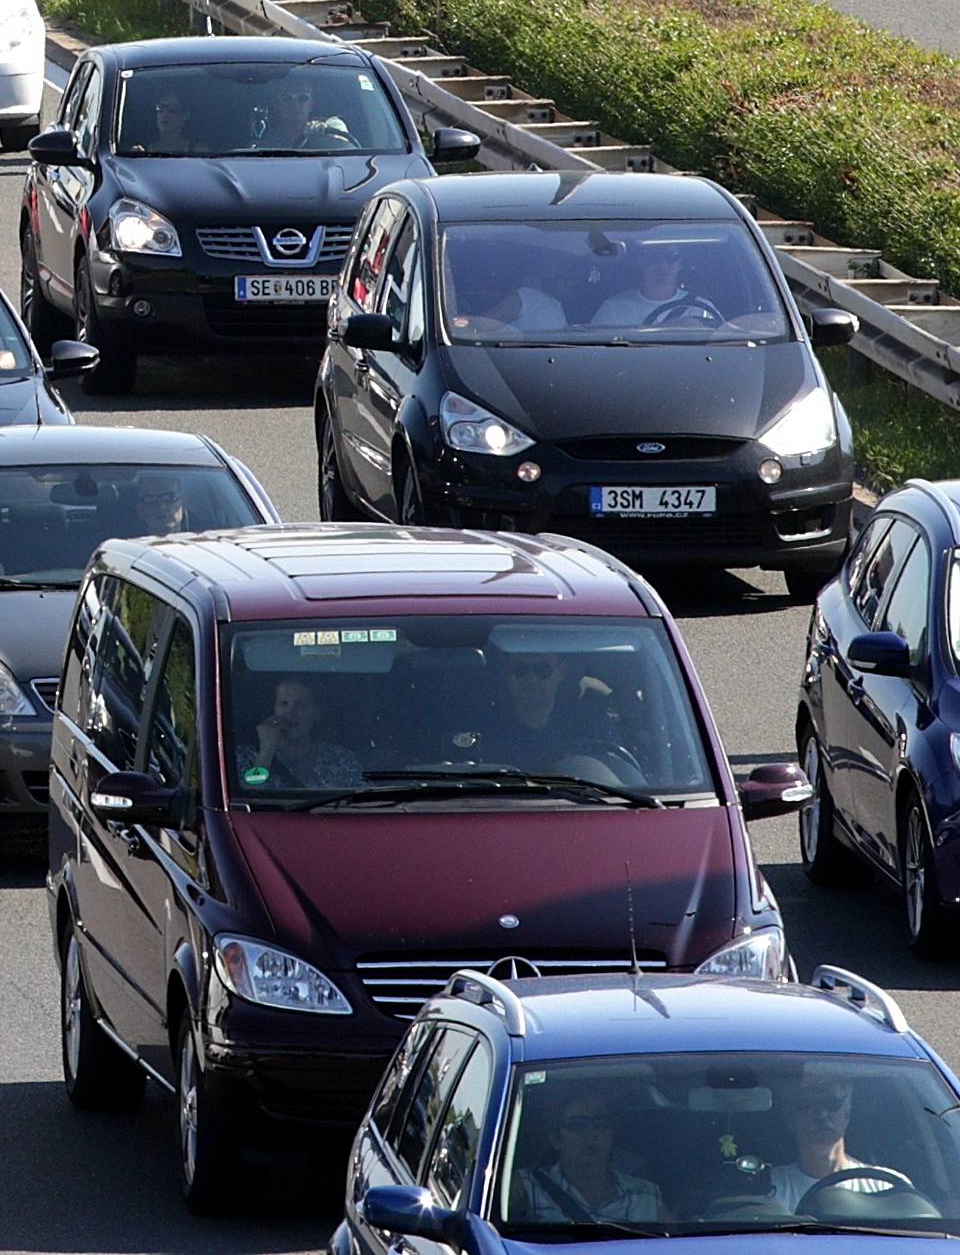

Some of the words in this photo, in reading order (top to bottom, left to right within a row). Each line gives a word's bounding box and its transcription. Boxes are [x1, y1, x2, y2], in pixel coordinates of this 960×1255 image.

[250, 279, 272, 297] SE
[285, 279, 316, 297] 406
[607, 489, 644, 510] 3SM
[658, 489, 706, 510] 4347
